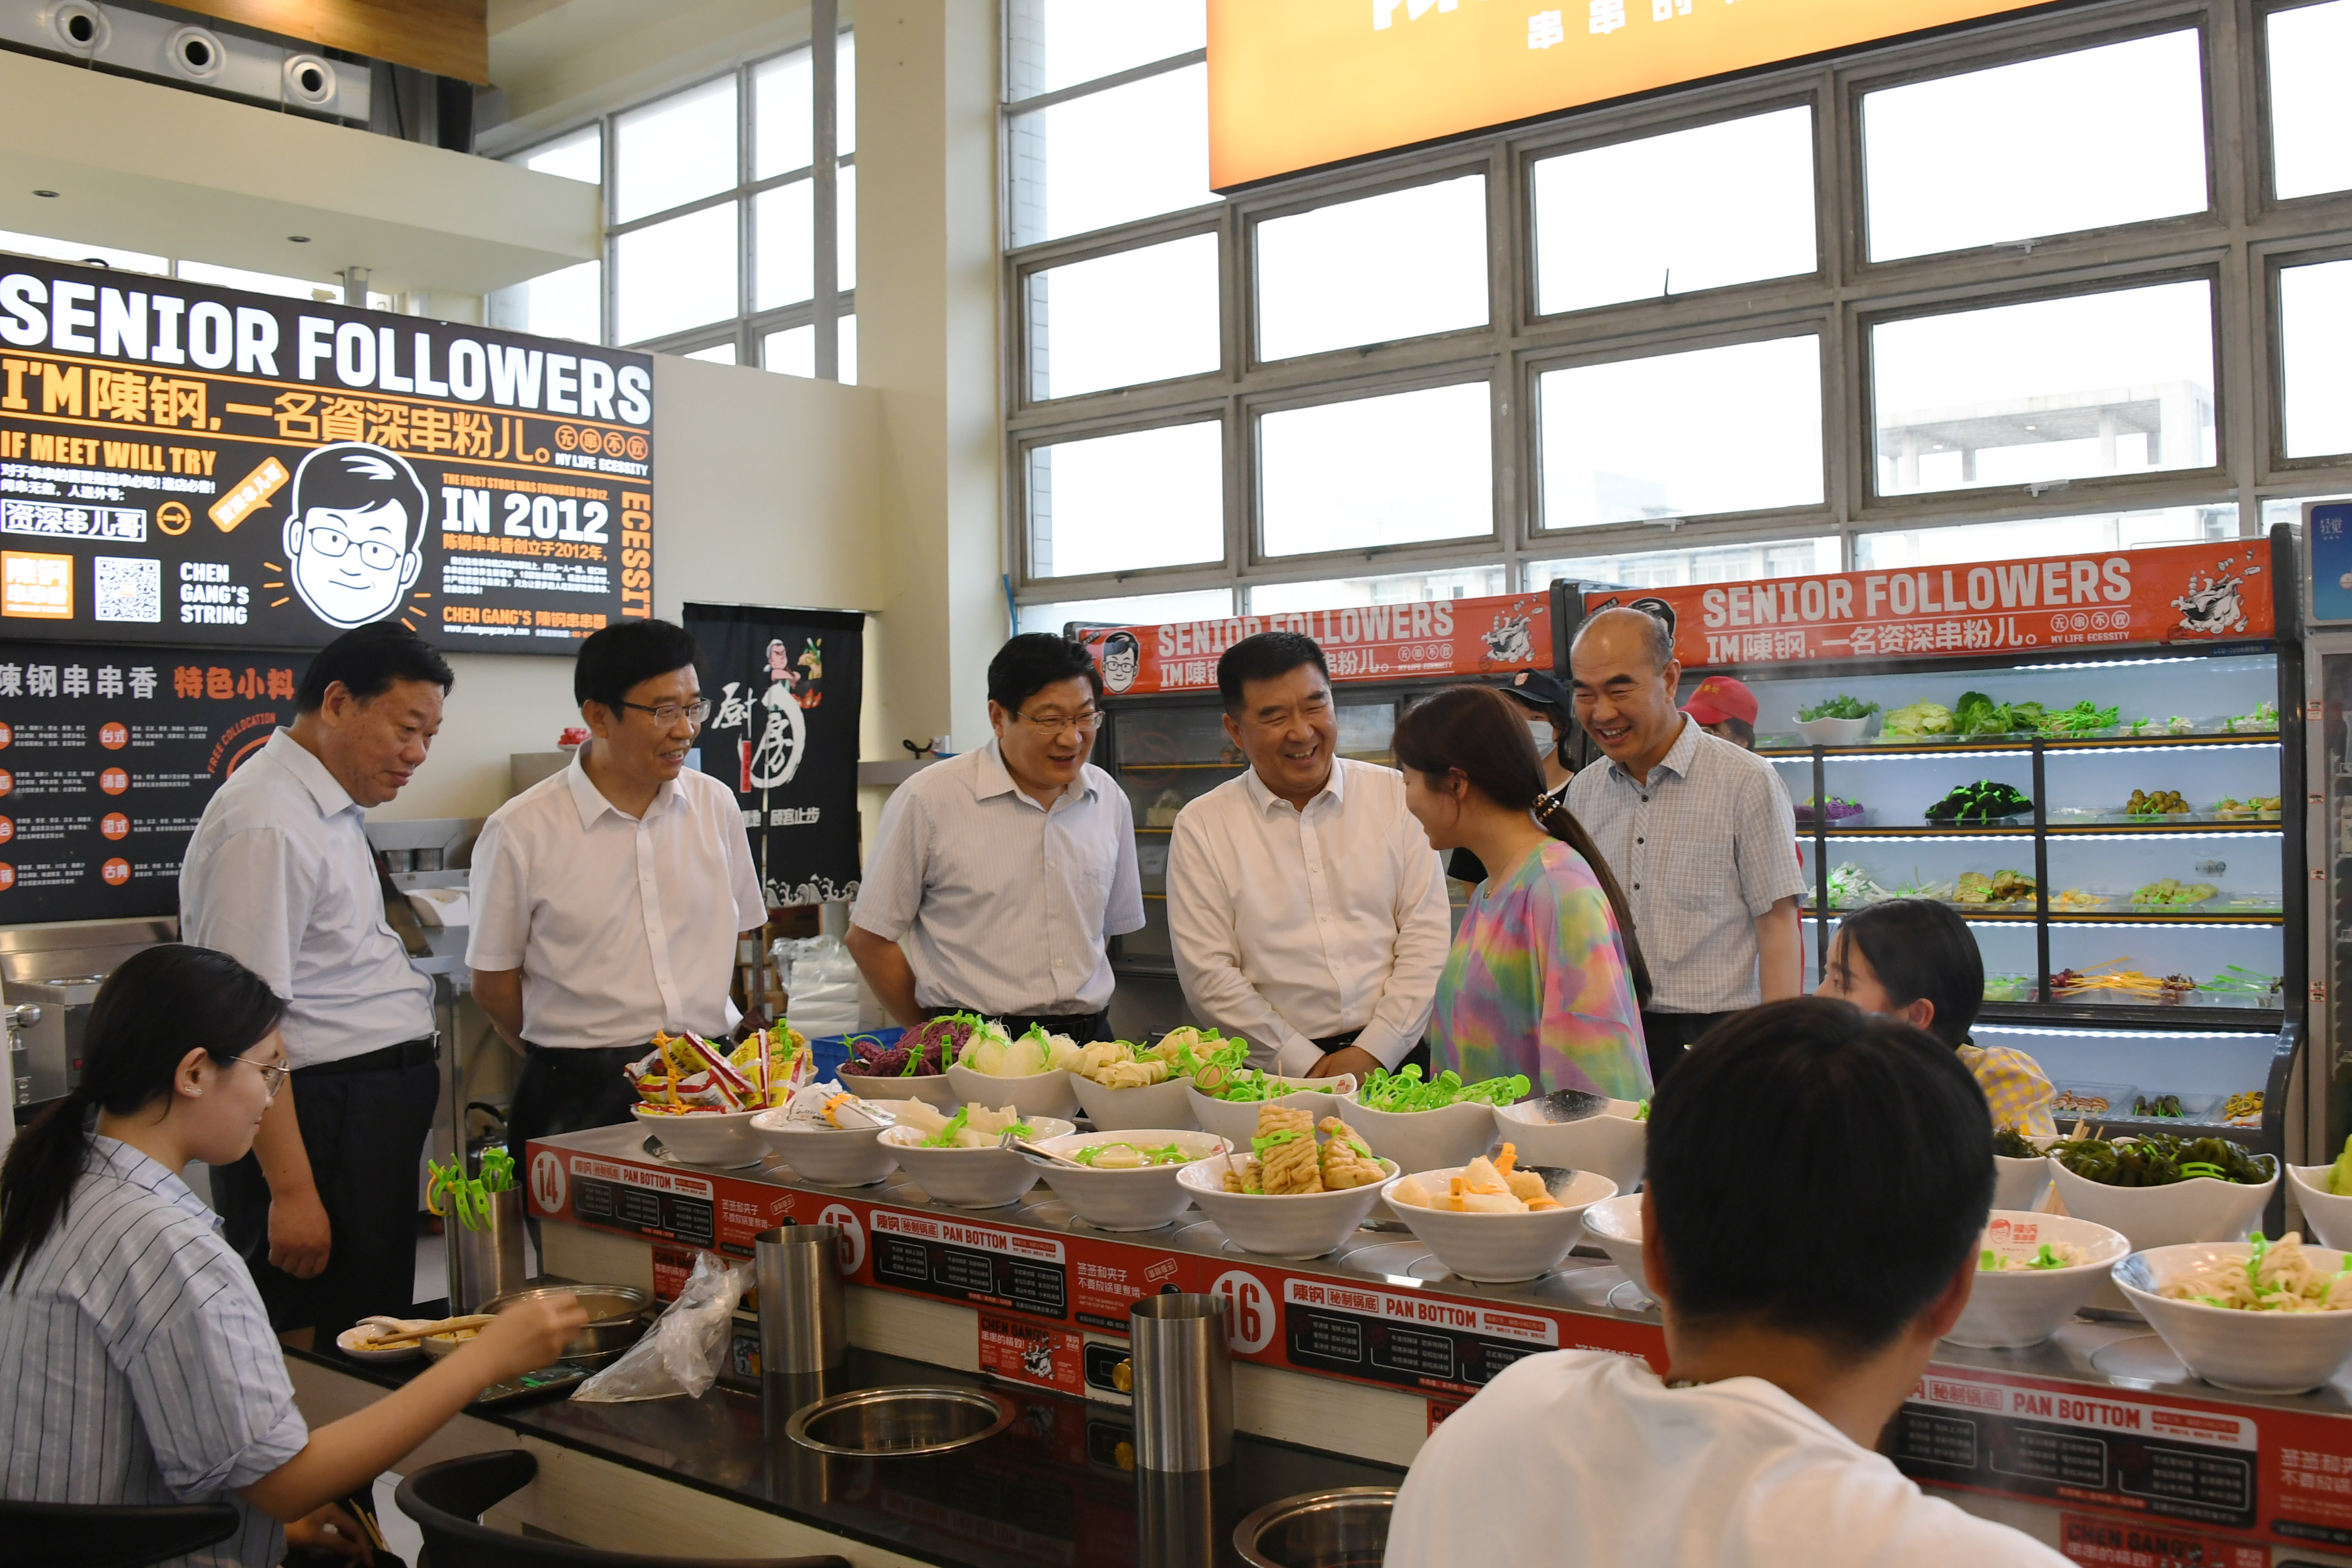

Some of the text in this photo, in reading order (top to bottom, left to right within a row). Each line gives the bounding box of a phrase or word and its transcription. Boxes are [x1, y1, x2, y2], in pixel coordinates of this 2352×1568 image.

[0, 273, 652, 425] SENIOR FOLLOWERS
[1, 358, 83, 416] I'M
[0, 430, 217, 476] IF MEET WILL TRY
[555, 452, 649, 476] MY LIFE ECESSITY
[442, 472, 461, 486] THE
[461, 474, 487, 488] FIRST
[487, 476, 515, 491] STORE
[515, 479, 537, 493] WAS
[537, 482, 576, 497] FOUNDED
[5, 503, 142, 539] 资深串儿哥
[442, 486, 609, 544] IN 2012
[180, 561, 230, 583] CHEN
[180, 583, 250, 605] GANG'S
[1702, 557, 2131, 630] SENIOR FOLLOWERS
[180, 604, 248, 625] STRING
[442, 605, 480, 623] CHEN
[481, 607, 532, 626] GANG'S
[2052, 611, 2129, 631] 无串不欢
[1706, 636, 1739, 664] IM
[2050, 631, 2130, 644] MY LIFE ECESSITY
[173, 665, 295, 701] 特色小料
[207, 742, 225, 774] FREE
[537, 1158, 558, 1205] 14
[623, 1168, 639, 1184] PAN
[640, 1171, 671, 1189] BOTTOM
[943, 1225, 963, 1242] PAN
[965, 1228, 1007, 1250] BOTTOM
[1077, 1261, 1128, 1283] 签签和夹子
[1293, 1283, 1324, 1304] 陳钢
[1329, 1290, 1377, 1311] 秘制锅底
[1386, 1298, 1414, 1319] PAN
[1418, 1303, 1476, 1328] BOTTOM
[2013, 1392, 2052, 1417] PAN
[2058, 1398, 2141, 1429] BOTTOM
[2068, 1522, 2123, 1548] CHEN
